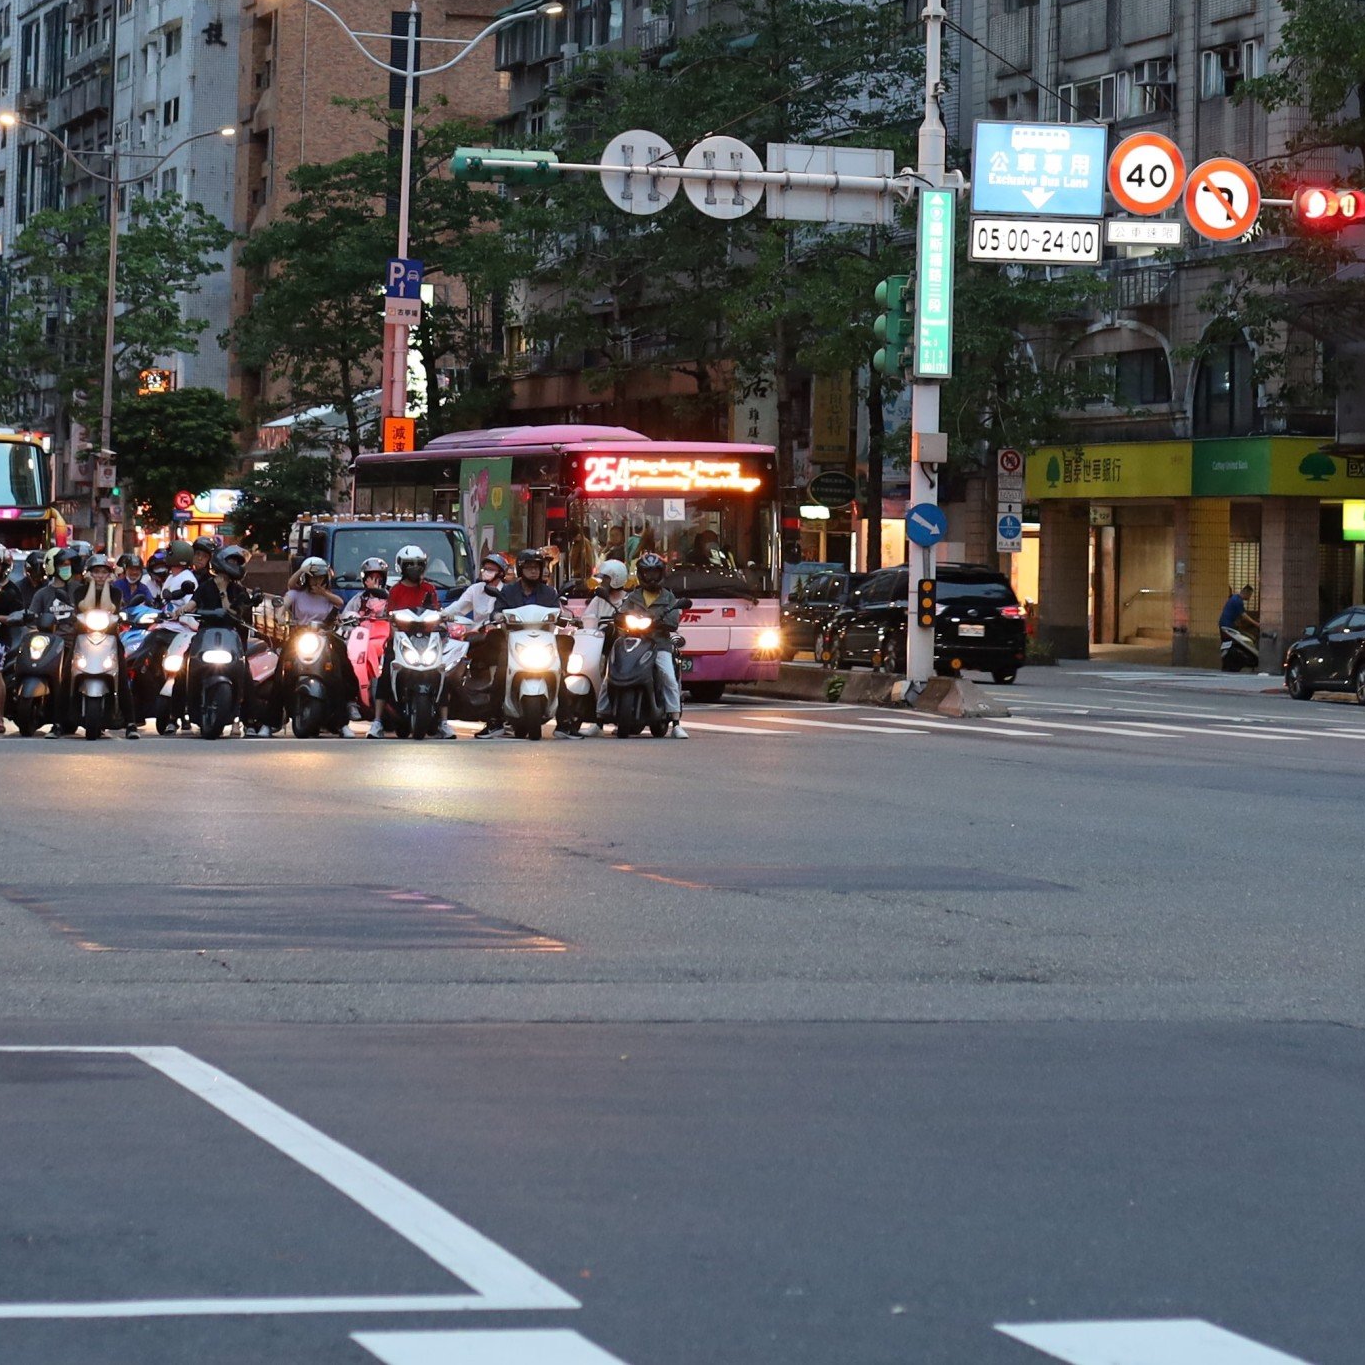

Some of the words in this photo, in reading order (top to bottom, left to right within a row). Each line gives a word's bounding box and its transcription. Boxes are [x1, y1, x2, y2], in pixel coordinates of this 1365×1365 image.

[989, 151, 1090, 176] 公車專用
[1126, 163, 1167, 188] 40
[988, 173, 1037, 186] Exclusive
[1040, 174, 1060, 187] Bus
[1063, 176, 1089, 188] Lane
[978, 227, 1094, 254] 05:00~24:00
[1115, 226, 1174, 239] 公車速限
[390, 262, 405, 287] P
[585, 457, 630, 491] 254
[1063, 458, 1122, 484] 國泰世華銀行
